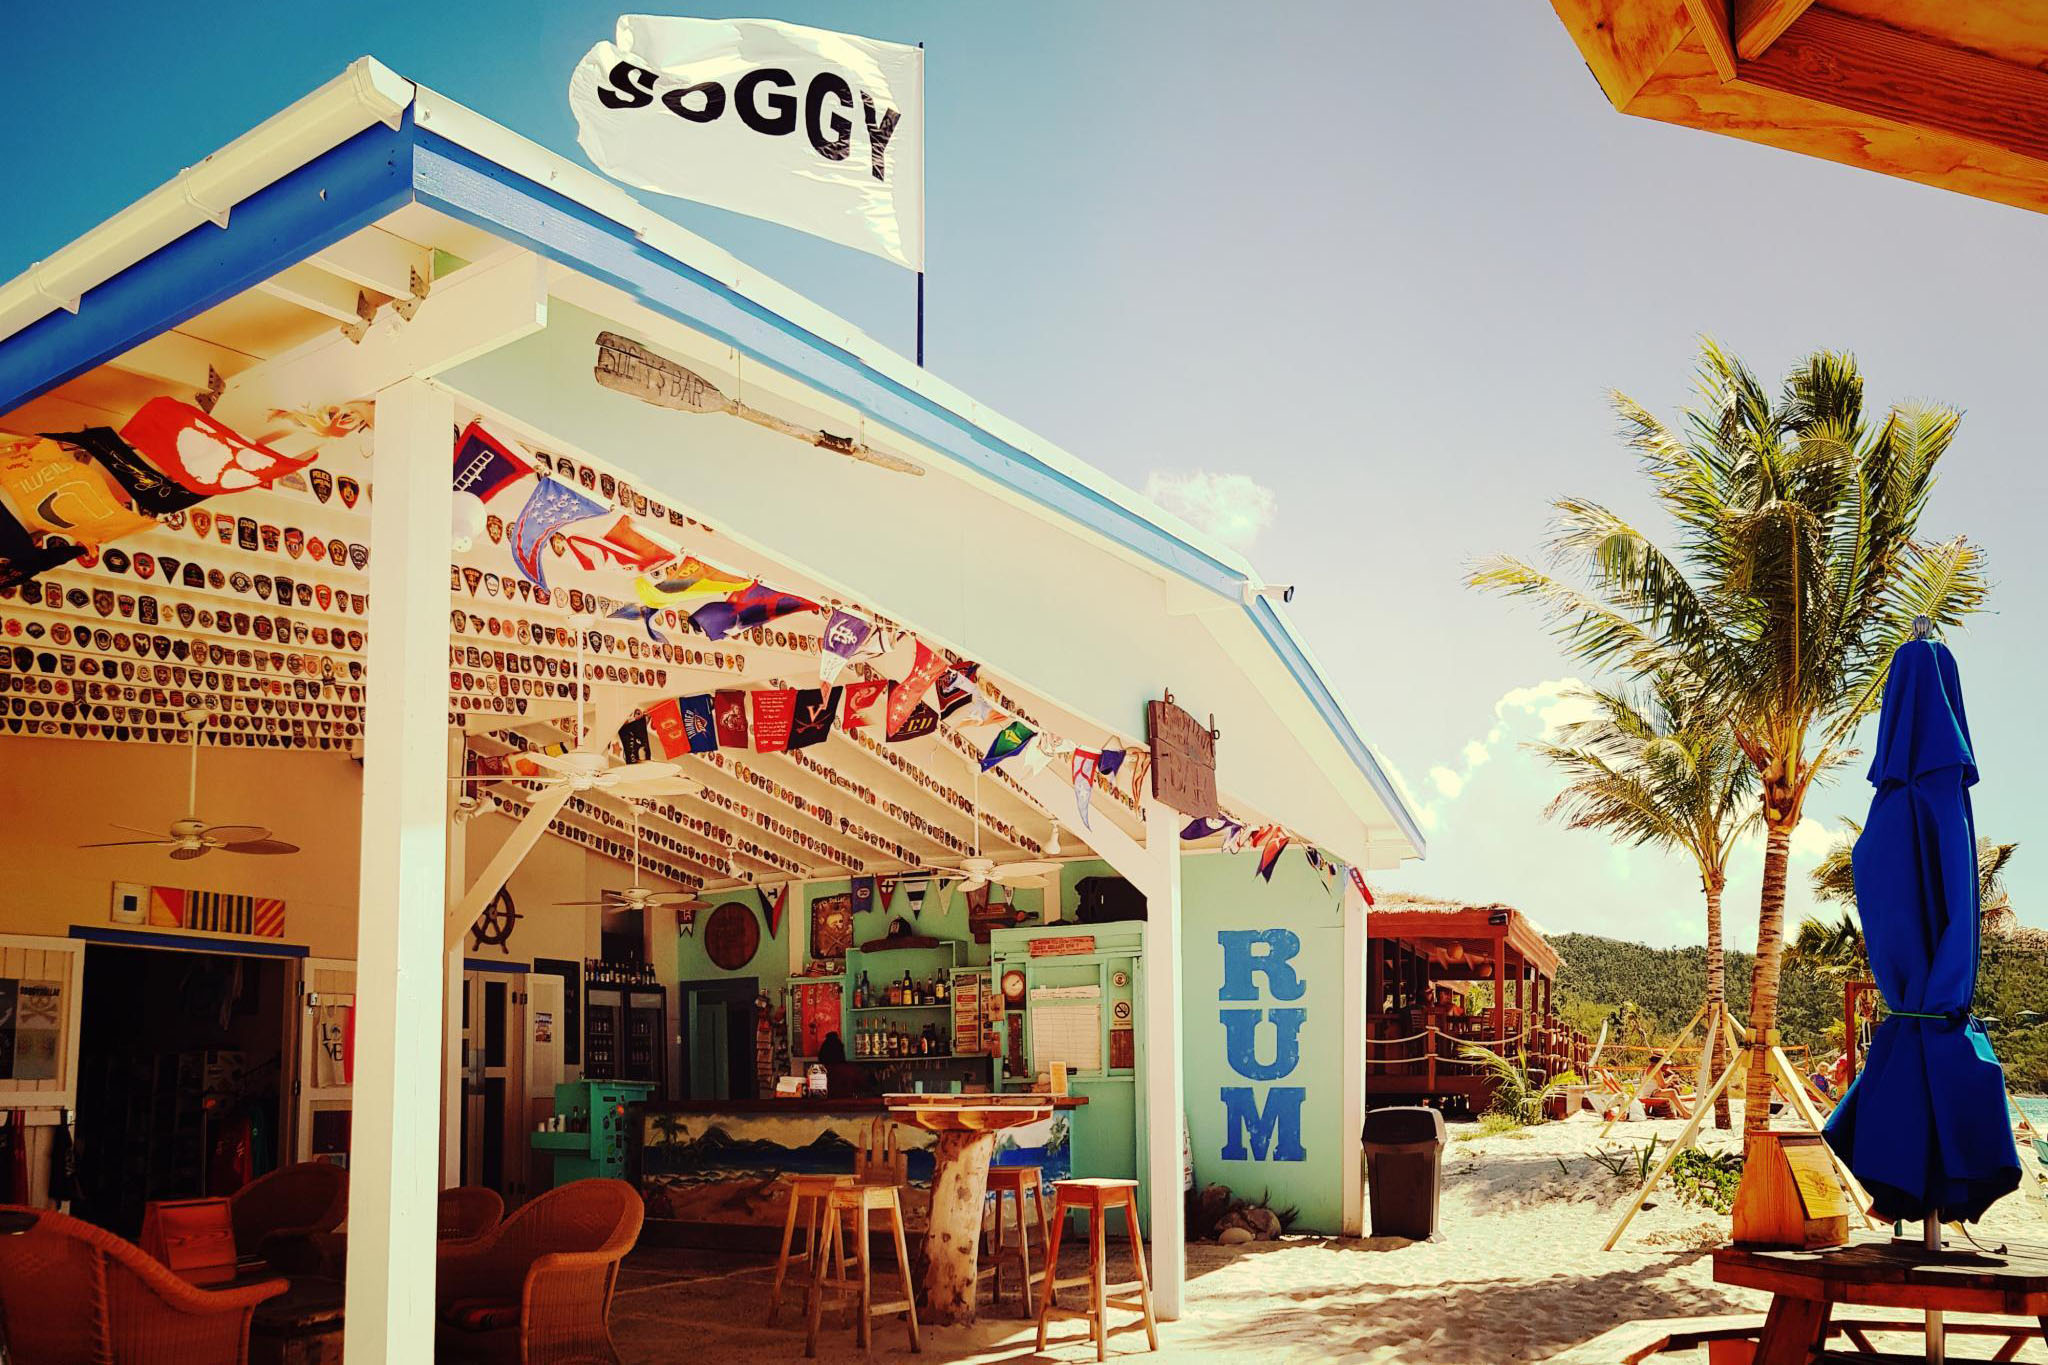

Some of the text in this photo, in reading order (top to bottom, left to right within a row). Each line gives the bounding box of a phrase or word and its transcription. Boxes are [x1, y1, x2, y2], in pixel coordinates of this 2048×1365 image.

[597, 61, 901, 182] SOGGY
[671, 371, 705, 408] BAR
[1218, 928, 1307, 1162] RUM
